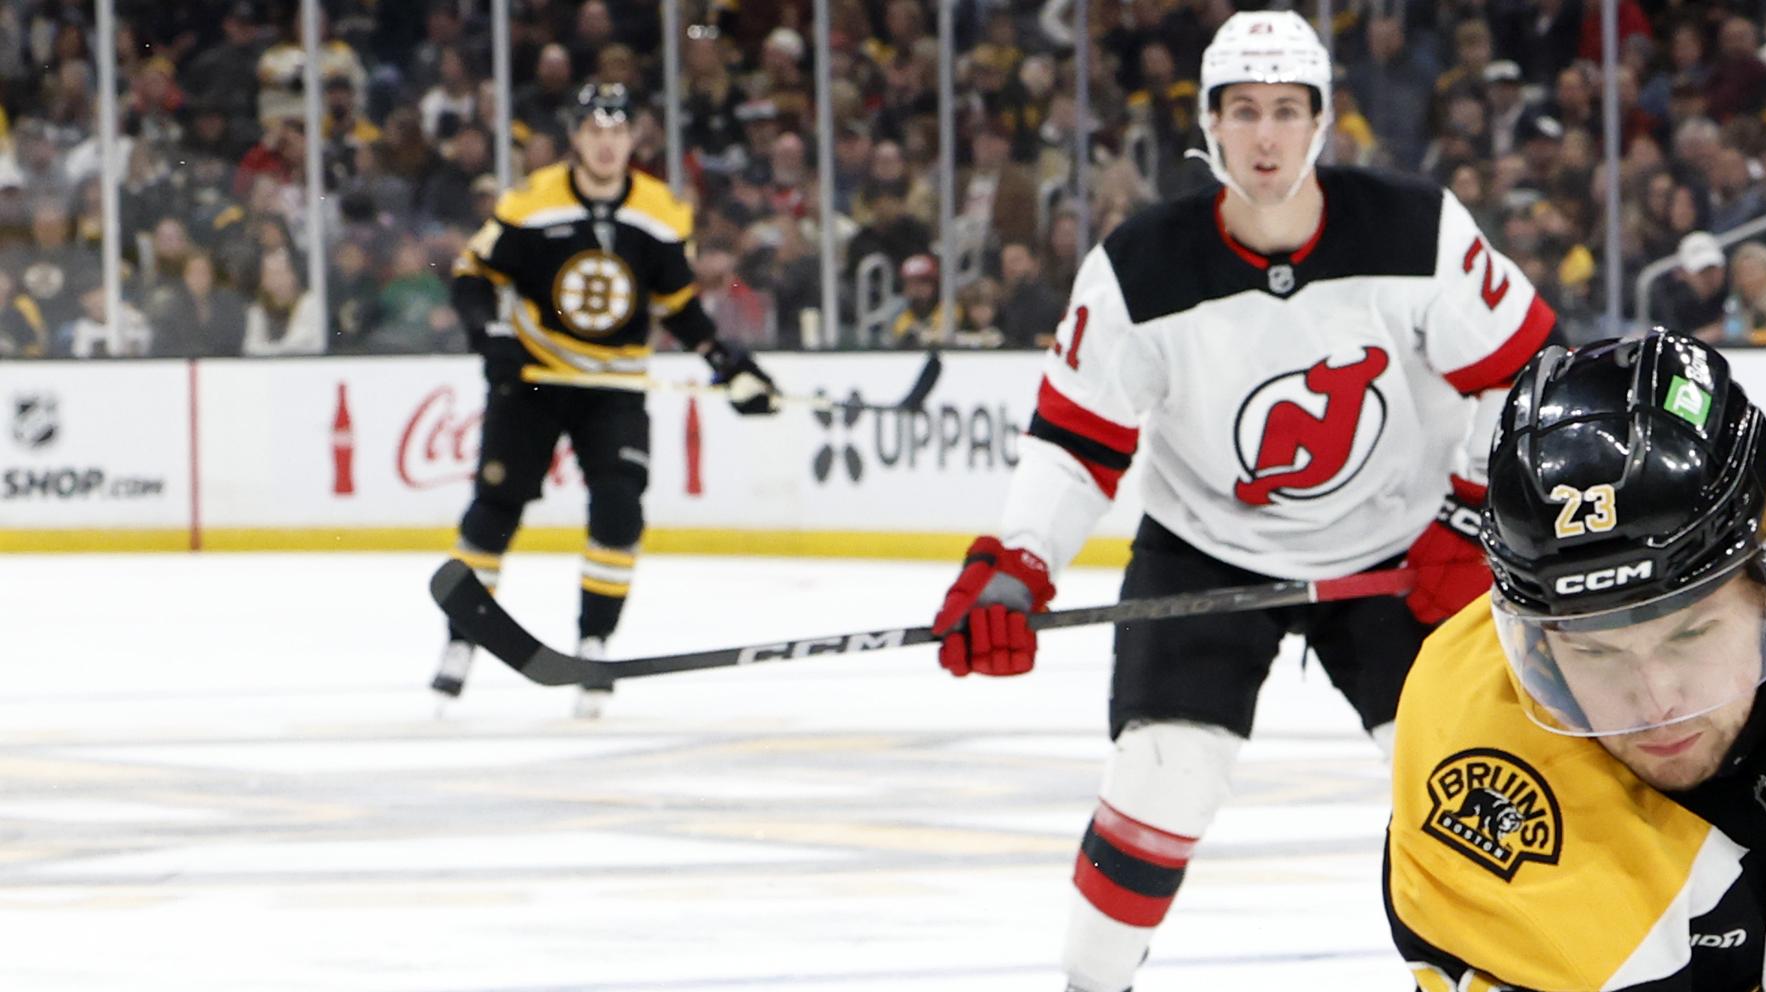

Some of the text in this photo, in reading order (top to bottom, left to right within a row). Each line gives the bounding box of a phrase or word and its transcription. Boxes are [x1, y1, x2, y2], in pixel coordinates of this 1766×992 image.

[1549, 483, 1617, 539] 23
[1555, 560, 1653, 595] CCM
[736, 629, 907, 666] CCM
[1437, 762, 1550, 849] BRUINS
